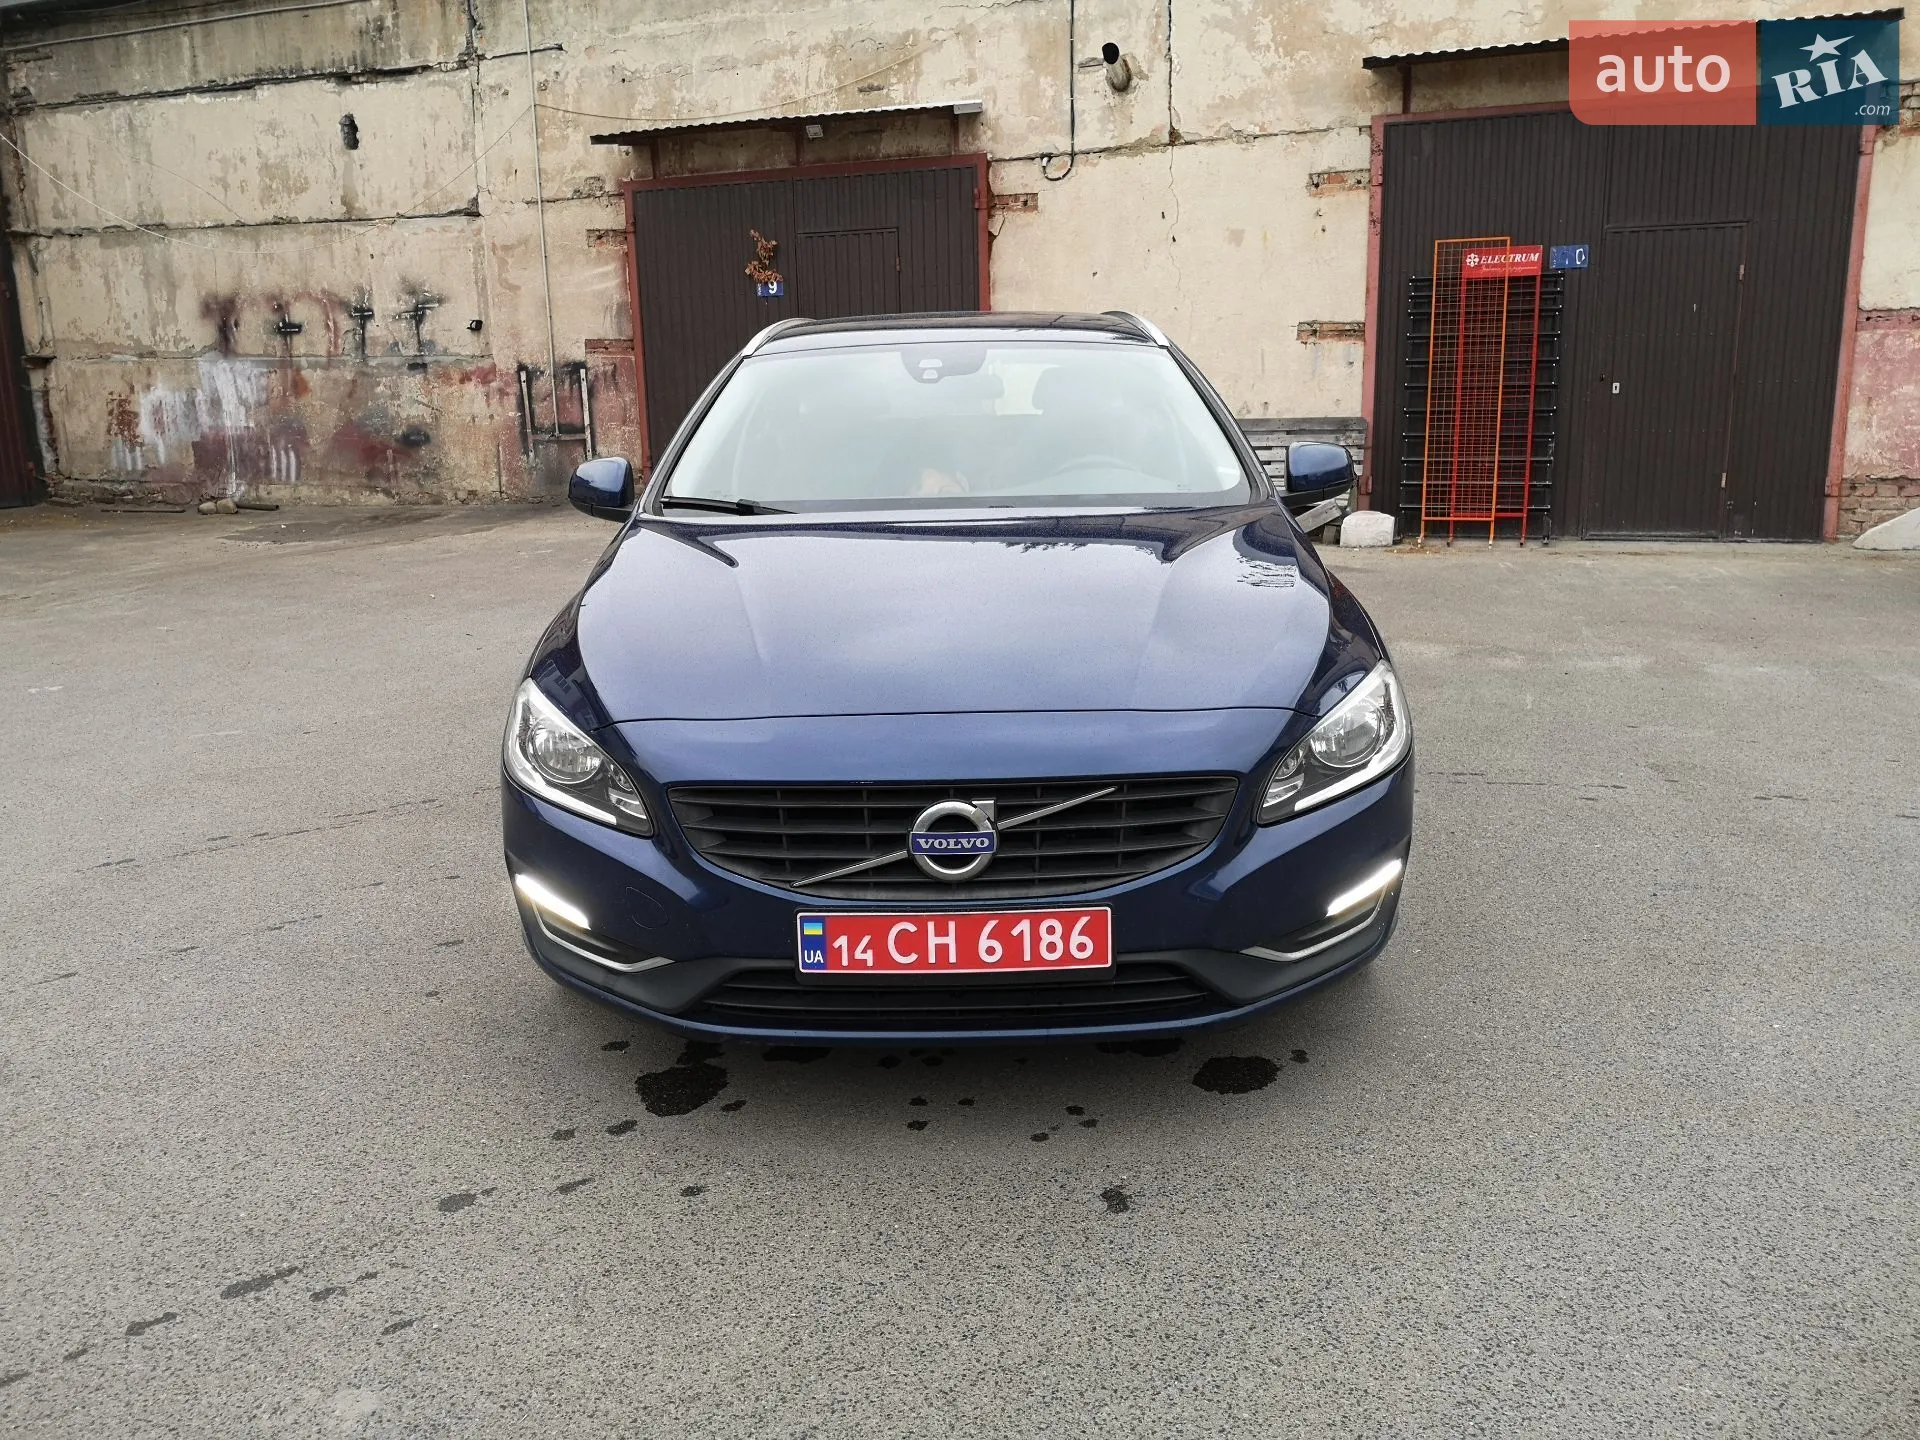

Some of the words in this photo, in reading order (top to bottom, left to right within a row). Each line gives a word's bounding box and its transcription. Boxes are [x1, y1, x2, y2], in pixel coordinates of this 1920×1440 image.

[1480, 252, 1540, 264] ELECTRUM
[768, 280, 777, 294] 9
[916, 837, 990, 849] VOLVO
[832, 935, 874, 967] 14
[887, 920, 957, 965] CH
[977, 916, 1094, 964] 6186
[804, 950, 824, 964] UA
